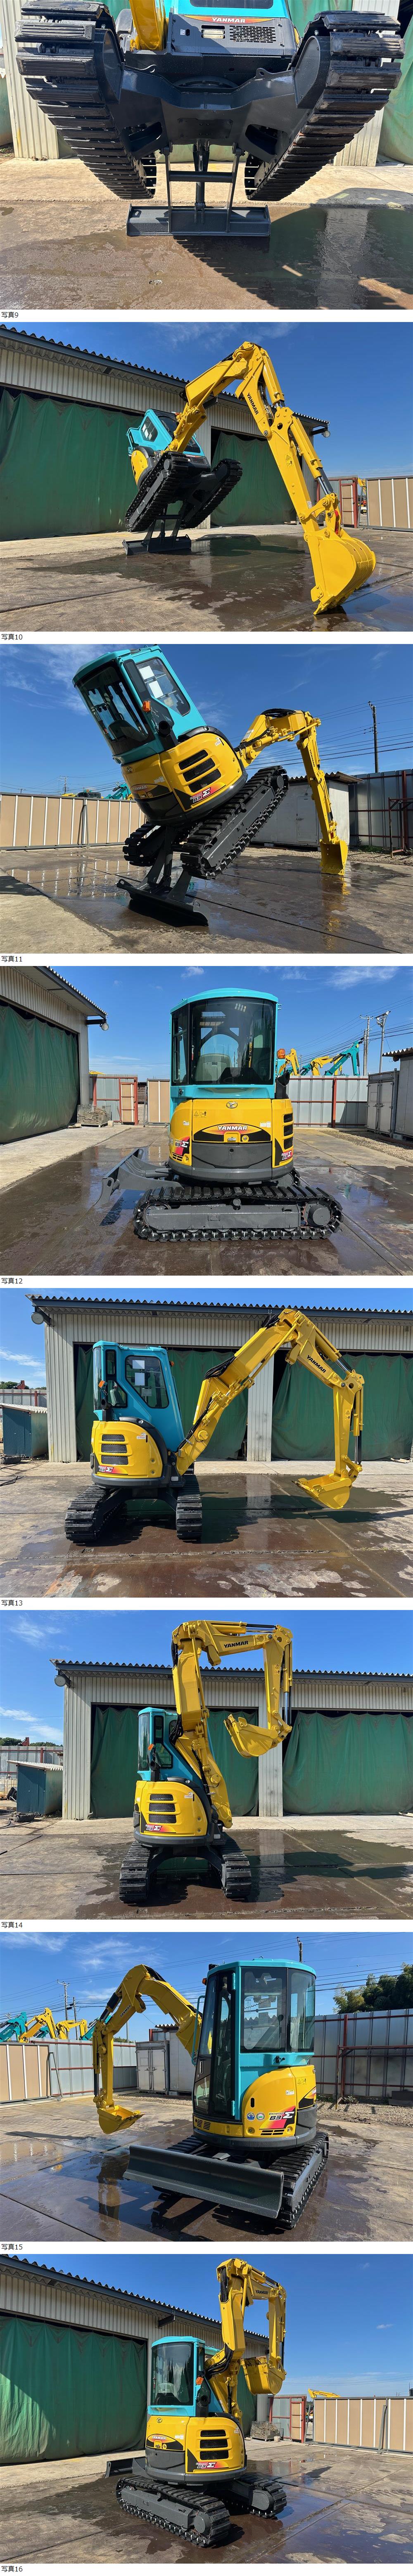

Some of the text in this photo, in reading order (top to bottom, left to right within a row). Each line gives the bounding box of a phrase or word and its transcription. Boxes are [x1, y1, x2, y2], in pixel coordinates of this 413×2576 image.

[247, 392, 259, 415] YANMAR
[307, 1354, 326, 1373] YANMAR
[120, 2004, 131, 2017] YANMAR
